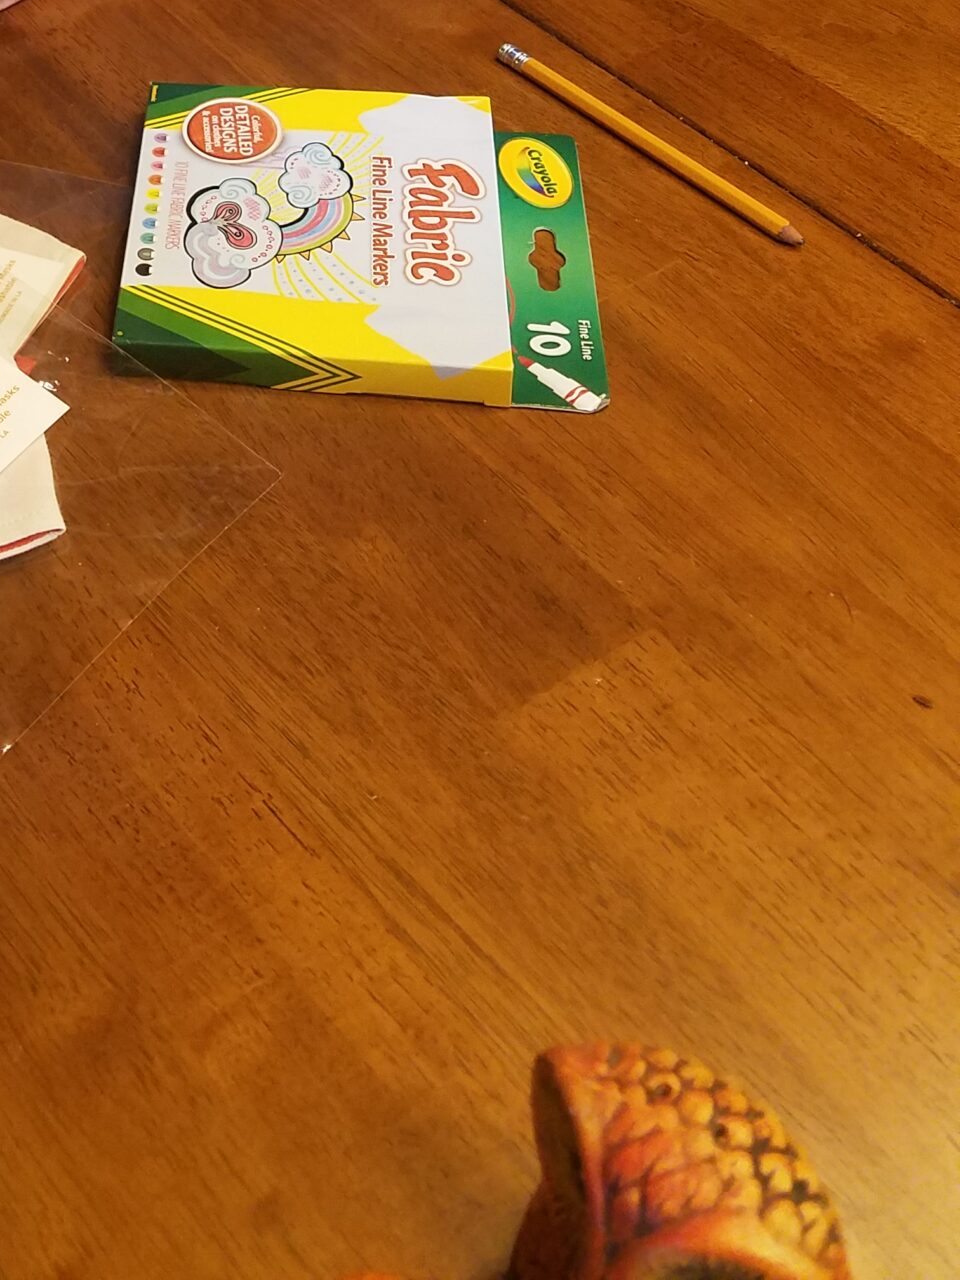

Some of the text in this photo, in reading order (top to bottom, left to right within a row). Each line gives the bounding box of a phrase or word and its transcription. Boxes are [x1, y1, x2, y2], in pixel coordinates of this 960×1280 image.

[212, 115, 218, 124] on
[220, 107, 237, 153] DESIGNS
[235, 105, 253, 156] DETAILED
[527, 148, 558, 196] Crayola
[371, 155, 395, 286] Fine Line Markers
[405, 160, 482, 285] Fabric
[527, 320, 572, 357] 10
[578, 319, 595, 361] Fine Line
